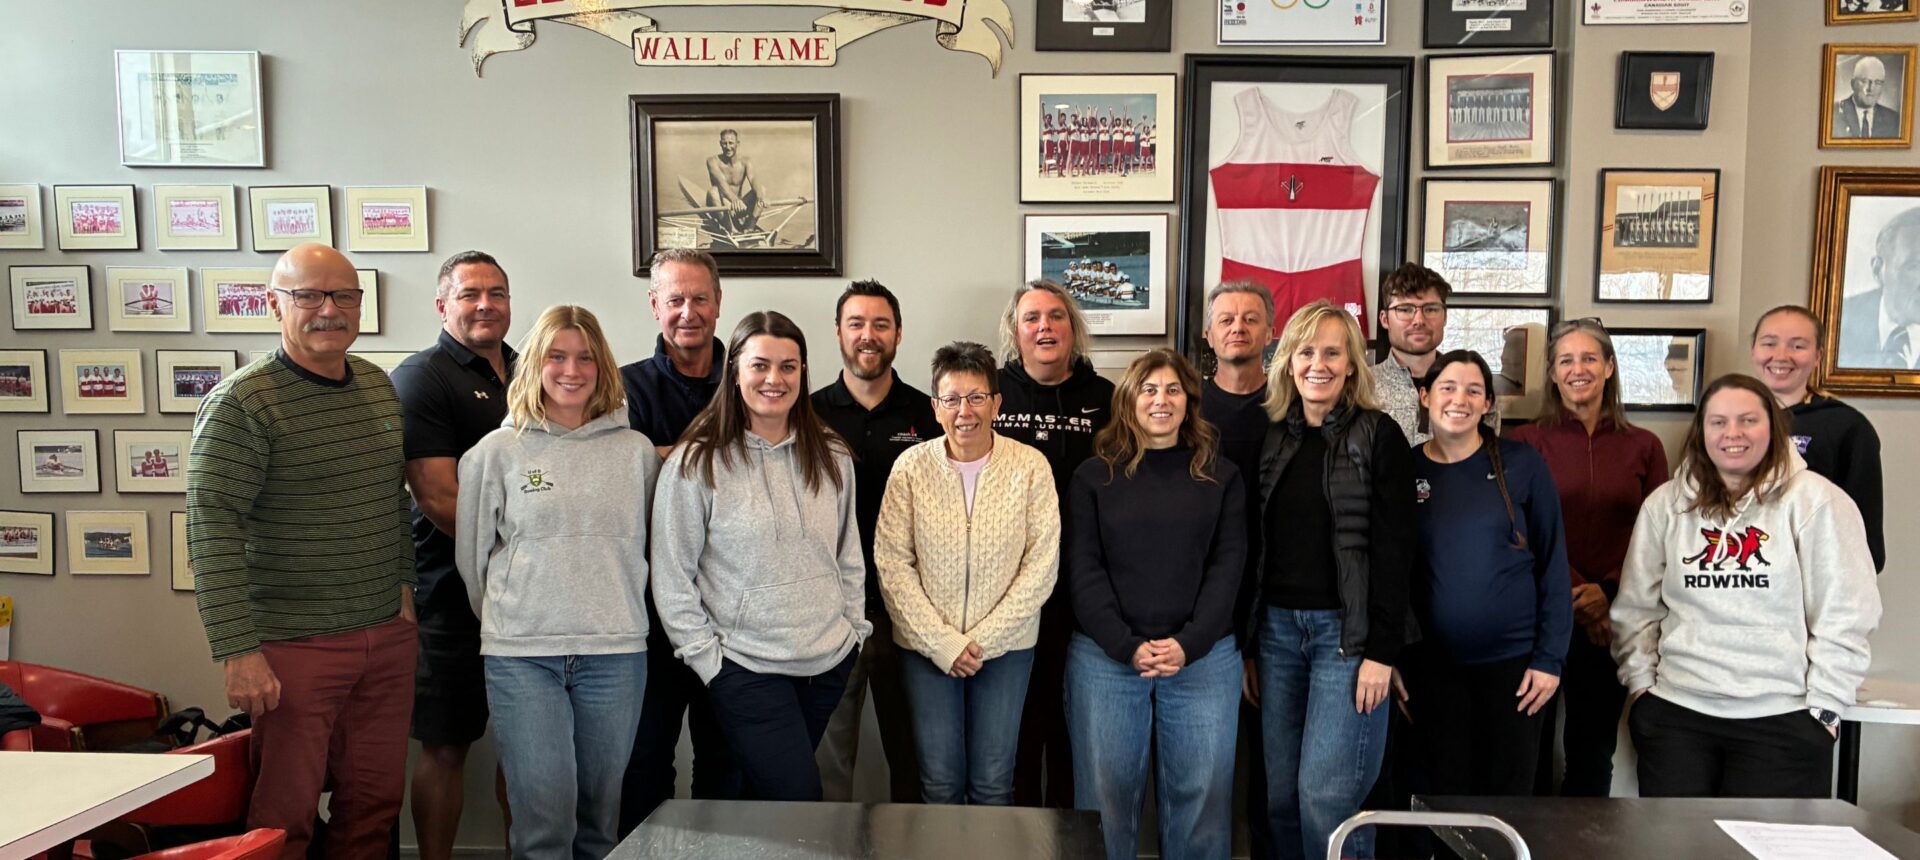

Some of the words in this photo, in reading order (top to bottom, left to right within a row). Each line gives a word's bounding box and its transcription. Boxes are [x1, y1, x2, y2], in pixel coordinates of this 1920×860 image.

[636, 37, 716, 61] WALL
[724, 37, 742, 61] of
[753, 37, 829, 61] FAME
[1684, 574, 1770, 589] ROWING
